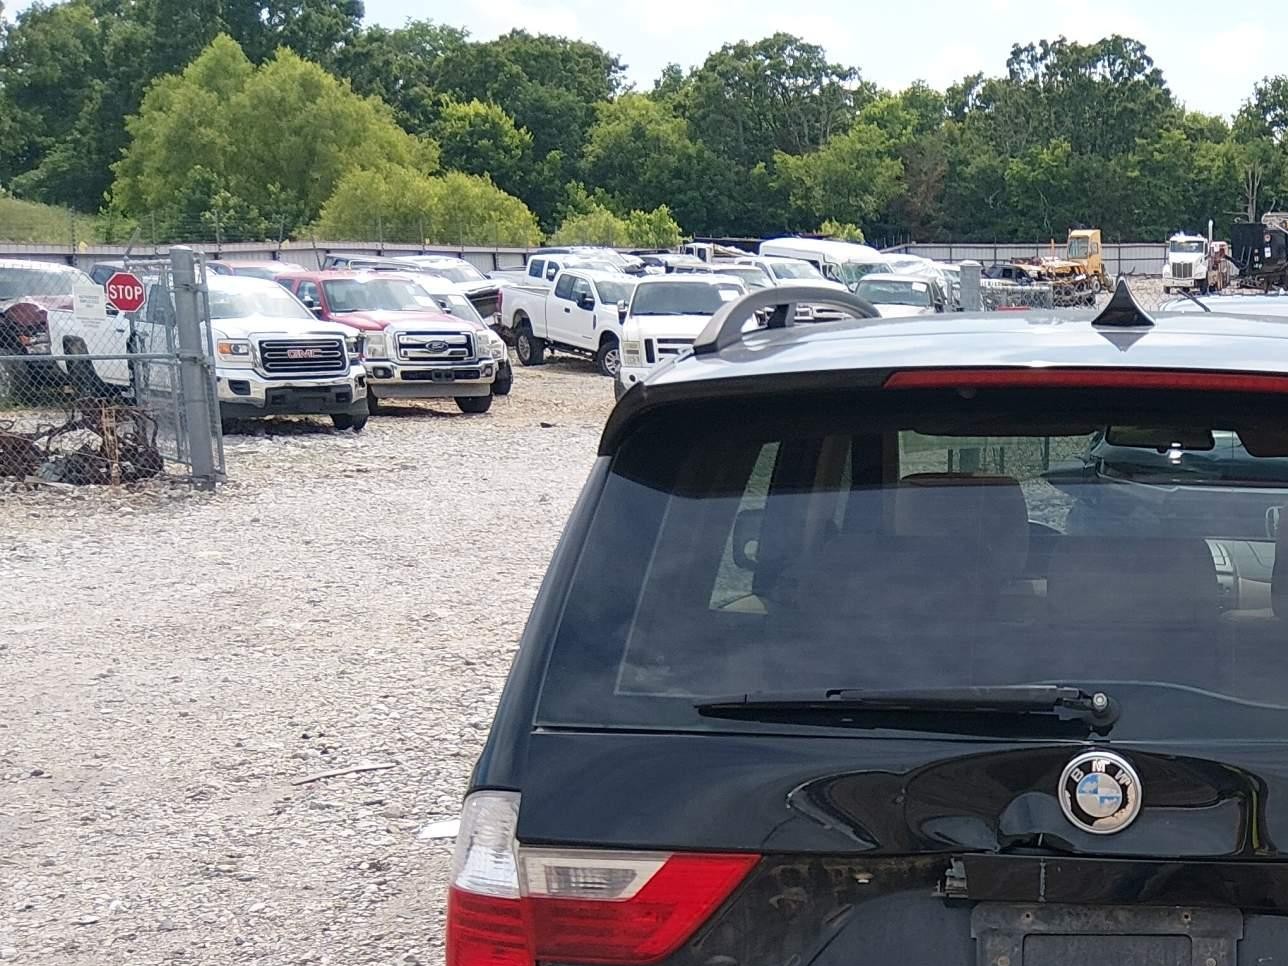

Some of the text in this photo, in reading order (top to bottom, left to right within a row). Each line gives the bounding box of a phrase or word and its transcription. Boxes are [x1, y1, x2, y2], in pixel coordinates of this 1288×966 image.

[109, 285, 142, 300] STOP
[287, 349, 322, 359] GMC
[1070, 758, 1132, 786] BMW
